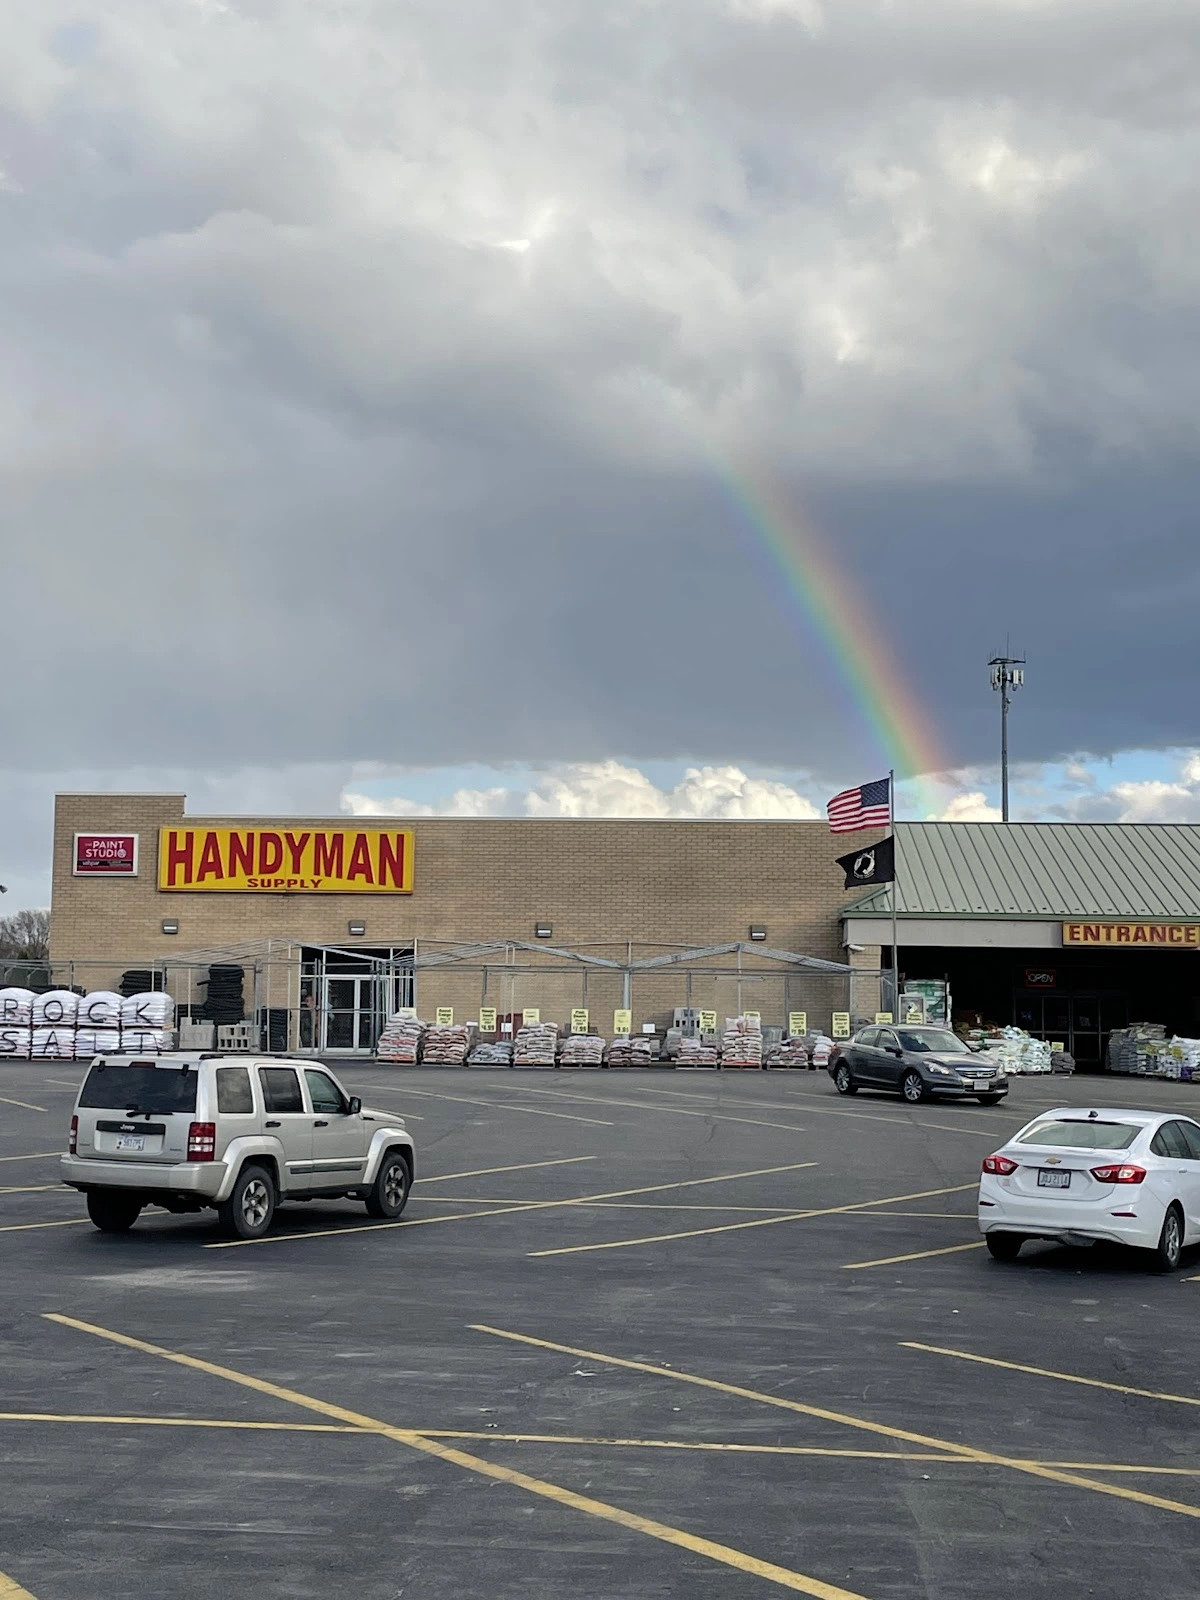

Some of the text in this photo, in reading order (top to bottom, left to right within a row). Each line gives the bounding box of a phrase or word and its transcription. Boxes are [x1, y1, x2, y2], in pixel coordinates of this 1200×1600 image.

[92, 840, 124, 849] PAINT
[85, 848, 127, 858] STUDIO
[167, 831, 404, 888] HANDYMAN
[247, 878, 323, 889] SUPPLY
[1068, 925, 1197, 943] ENTRANCE
[1029, 973, 1054, 983] OPEN
[3, 998, 154, 1025] ROCK
[0, 1030, 154, 1055] SALT
